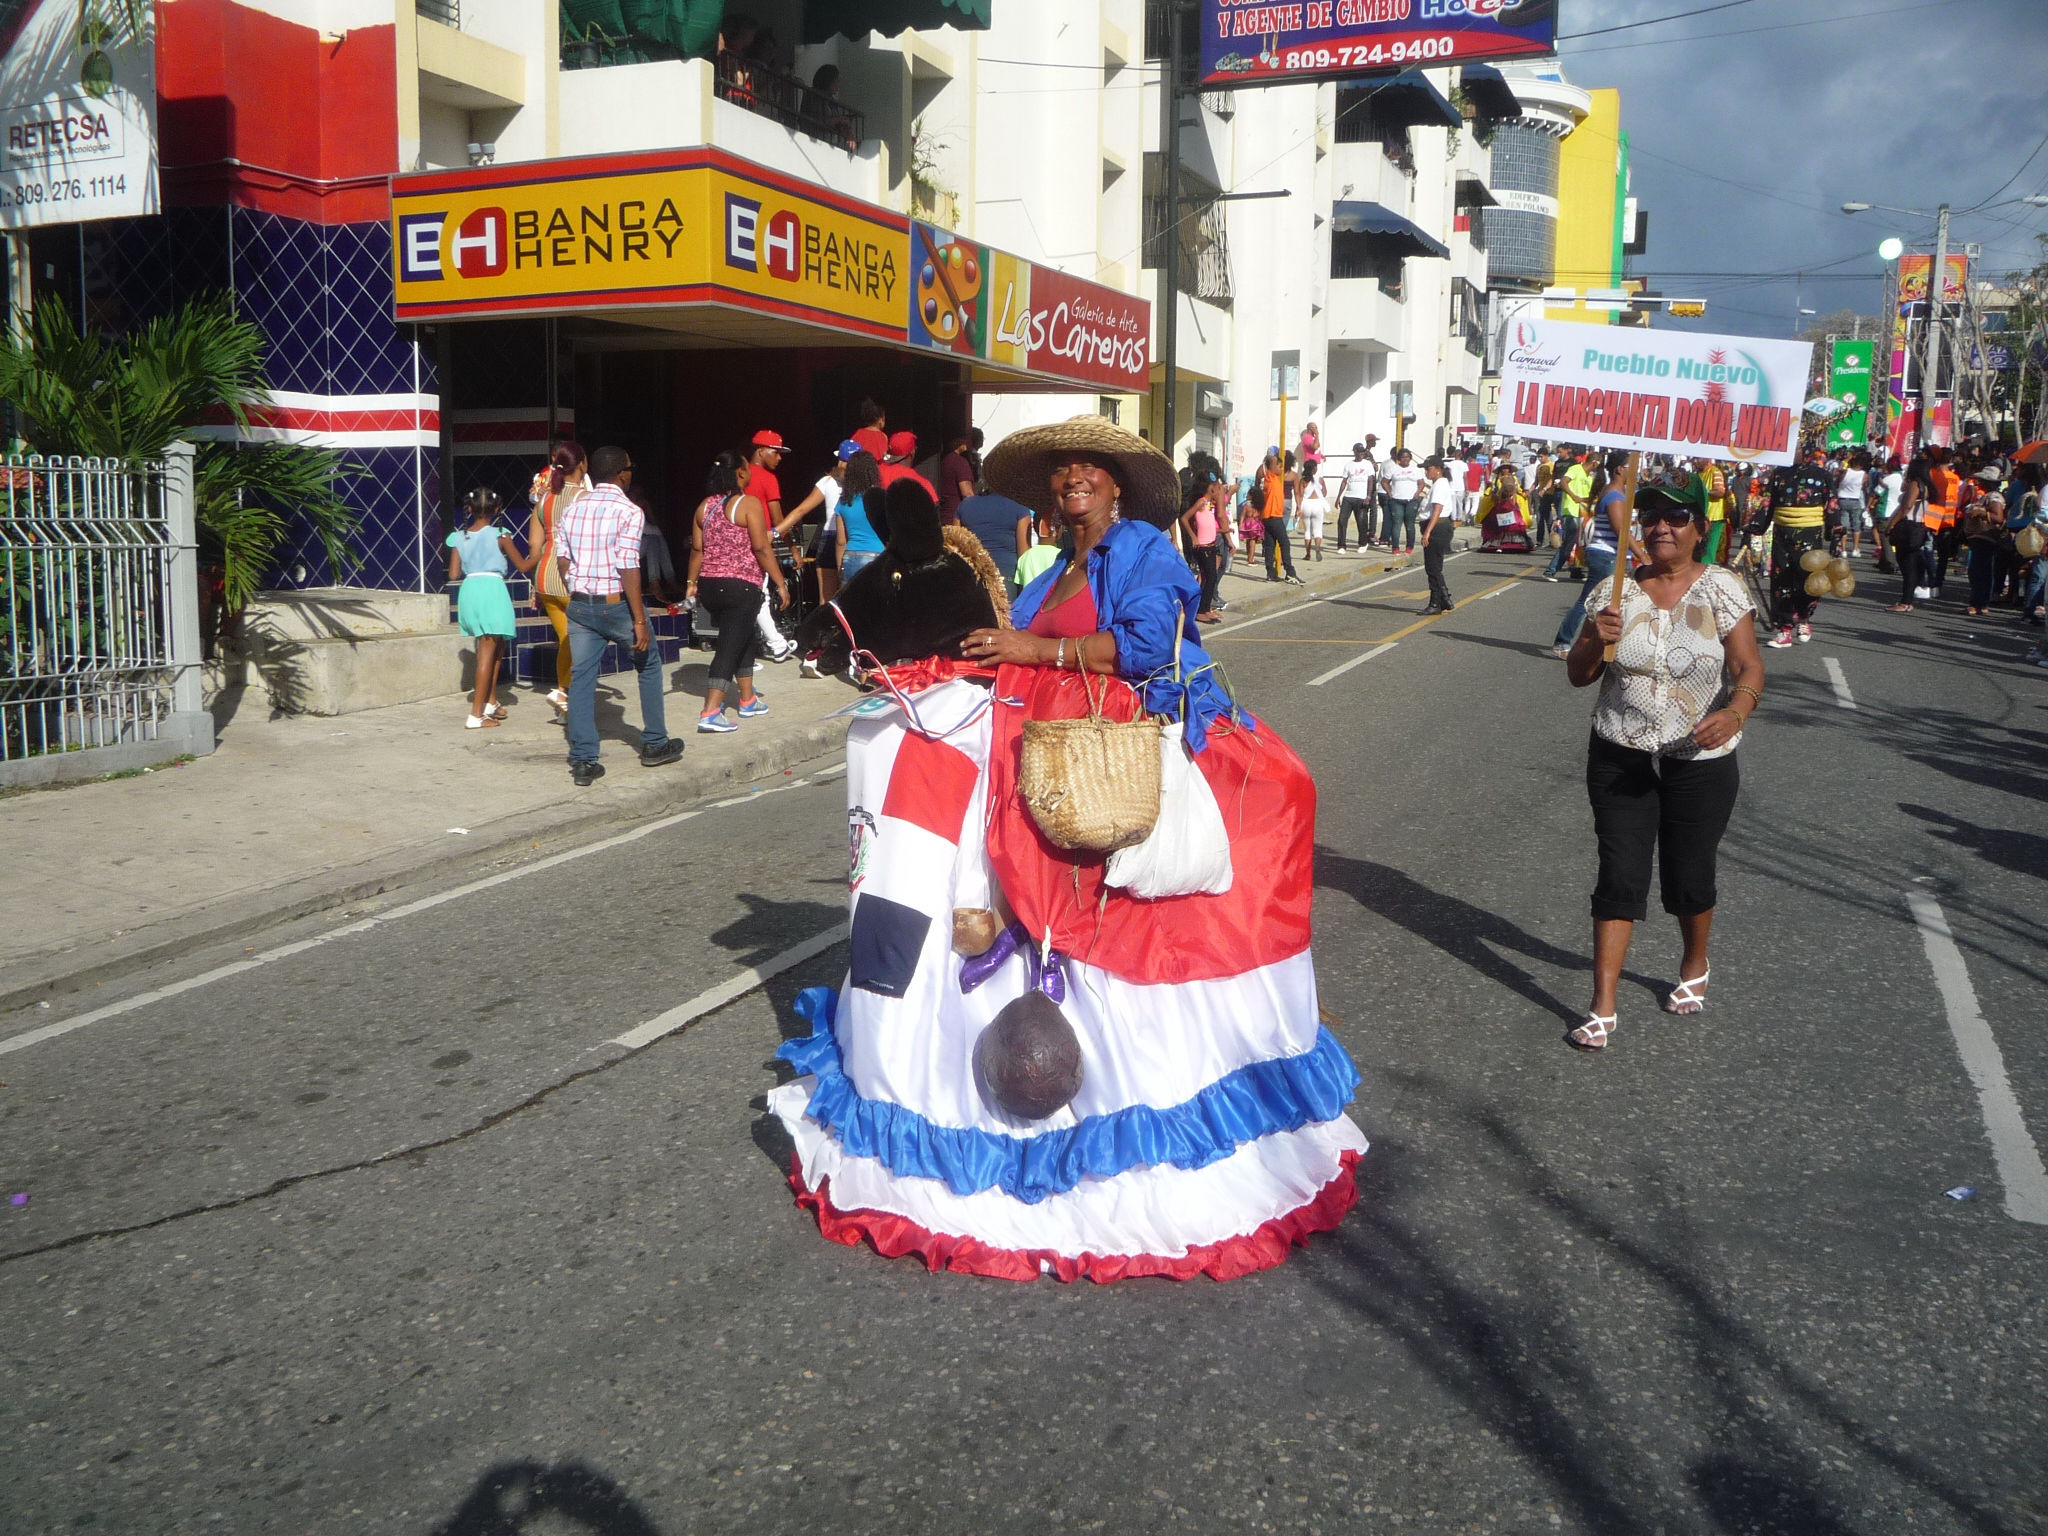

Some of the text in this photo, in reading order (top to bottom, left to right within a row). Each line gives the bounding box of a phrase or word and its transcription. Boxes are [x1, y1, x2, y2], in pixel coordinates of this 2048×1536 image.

[1218, 0, 1411, 38] Y AGENTE DE CAMBIO
[1286, 36, 1454, 69] 809-724-9400
[9, 113, 110, 150] RETECSA
[514, 197, 684, 241] BANCA
[515, 227, 684, 270] HENRY
[805, 223, 896, 277] BANCA
[805, 253, 896, 302] HENRY
[996, 280, 1146, 375] Las Carreras
[1106, 308, 1117, 328] de
[1119, 309, 1138, 334] Arte
[1508, 348, 1561, 366] Carnaval
[1583, 348, 1759, 385] Pueblo Nuevo
[1834, 366, 1870, 375] Presidente
[1513, 381, 1540, 425] LA
[1540, 383, 1671, 440] MARCHANTA
[1734, 403, 1792, 452] NINA
